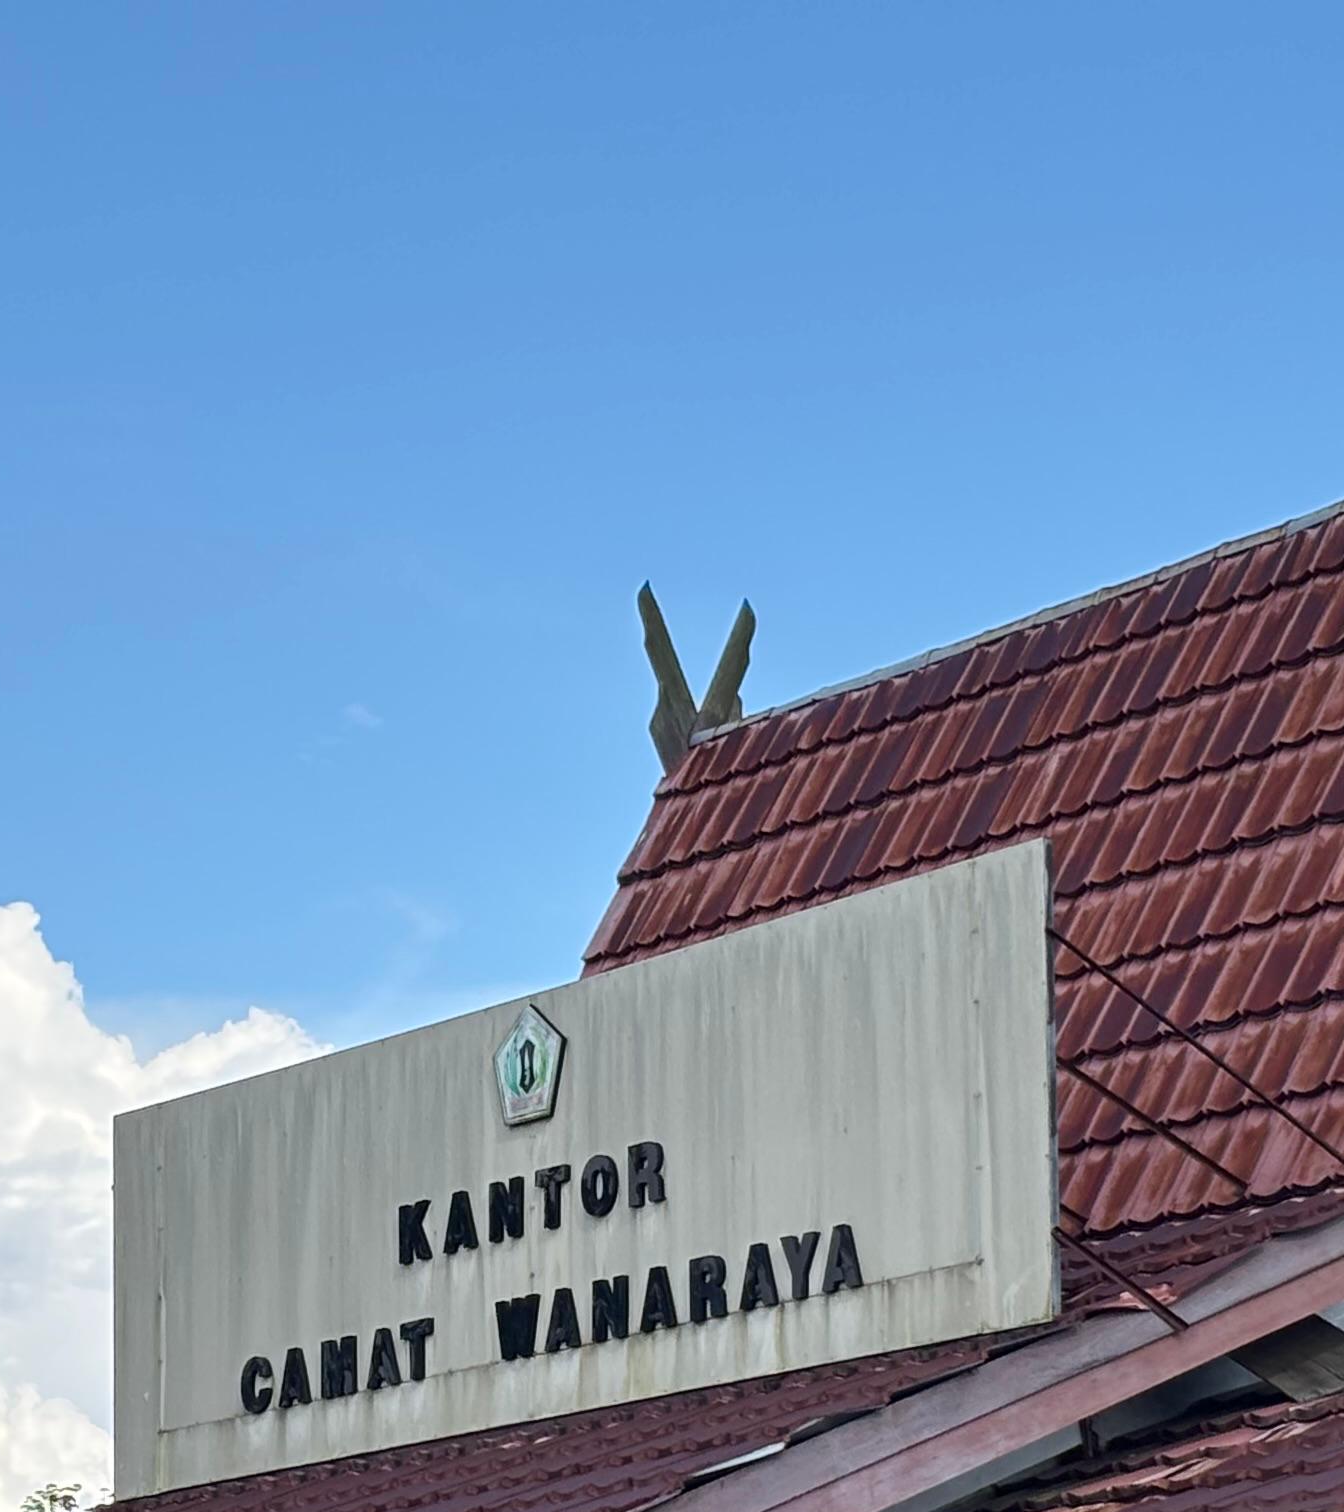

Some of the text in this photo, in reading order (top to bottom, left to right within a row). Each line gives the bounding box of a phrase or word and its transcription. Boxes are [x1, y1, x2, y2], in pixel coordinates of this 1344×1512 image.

[398, 1140, 666, 1265] KANTOR
[240, 1223, 863, 1414] CAMAT WANARAYA
